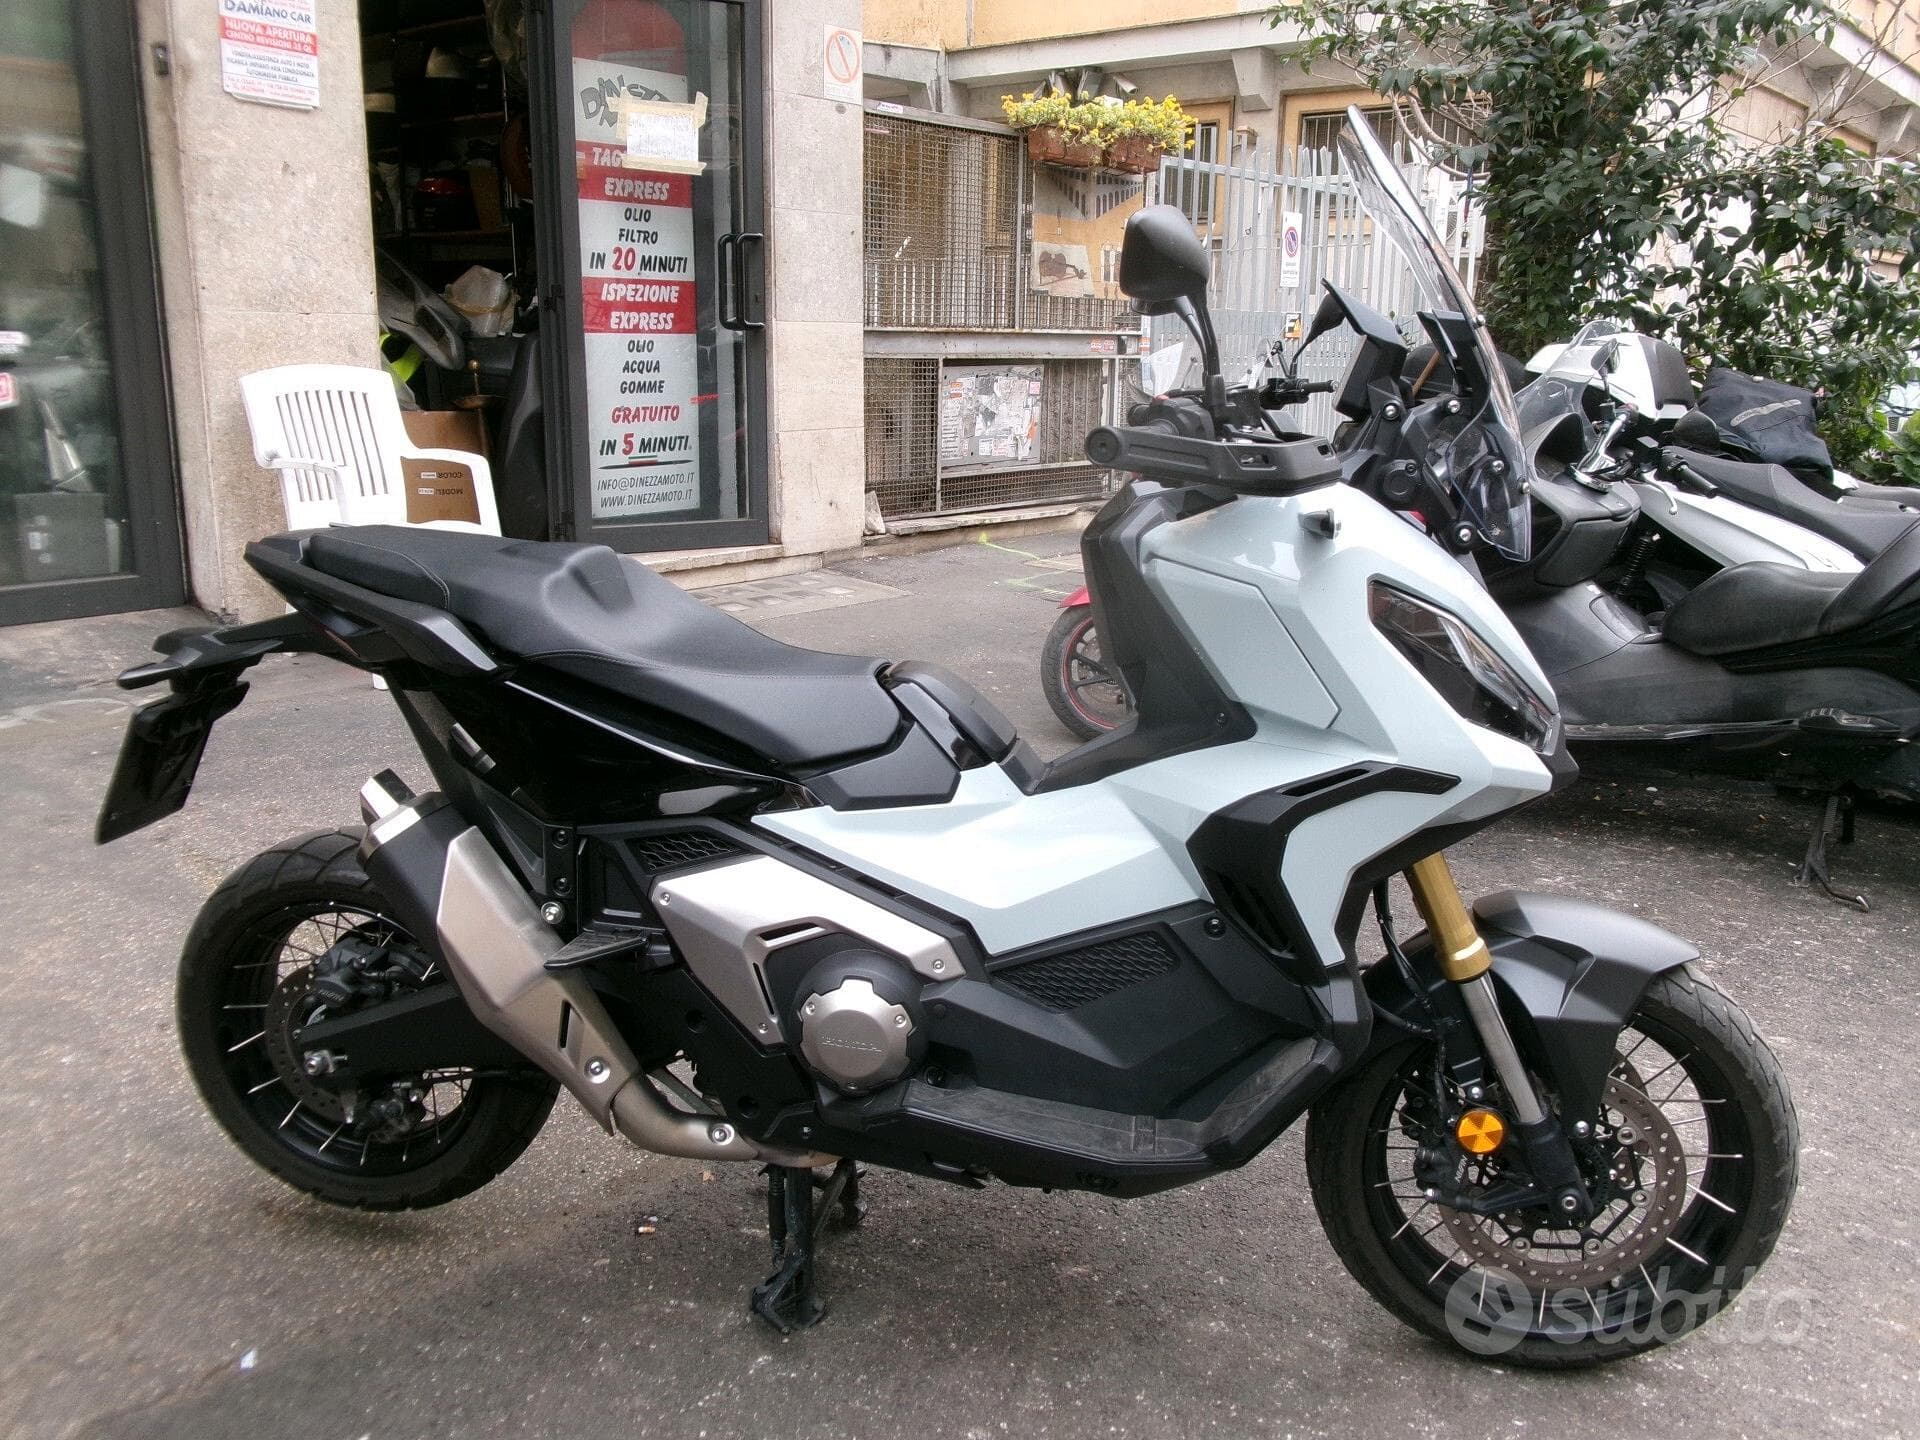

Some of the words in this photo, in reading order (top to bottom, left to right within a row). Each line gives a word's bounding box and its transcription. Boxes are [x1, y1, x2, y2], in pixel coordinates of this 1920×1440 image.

[224, 0, 288, 19] DAMIANO
[290, 11, 312, 24] CAR
[225, 18, 262, 35] NUOVA
[265, 25, 313, 45] APERTURA
[605, 177, 670, 201] EXPRESS
[624, 206, 652, 223] OLIO
[618, 228, 658, 244] FILTRO
[589, 252, 606, 269] IN
[612, 246, 636, 272] 20
[640, 254, 688, 274] MINUTI
[601, 283, 679, 303] ISPEZIONE
[610, 311, 674, 330] EXPRESS
[627, 339, 654, 353] OLIO
[622, 360, 660, 375] ACQUA
[620, 380, 664, 394] GOMME
[611, 405, 680, 425] GRATUITO
[599, 438, 616, 456] IN
[622, 432, 635, 456] 5
[638, 435, 689, 454] MINUTI
[597, 472, 695, 492] INFO@DINEZZAMOTO.IT
[600, 489, 693, 509] WWW.DINEZZAMOTO.IT
